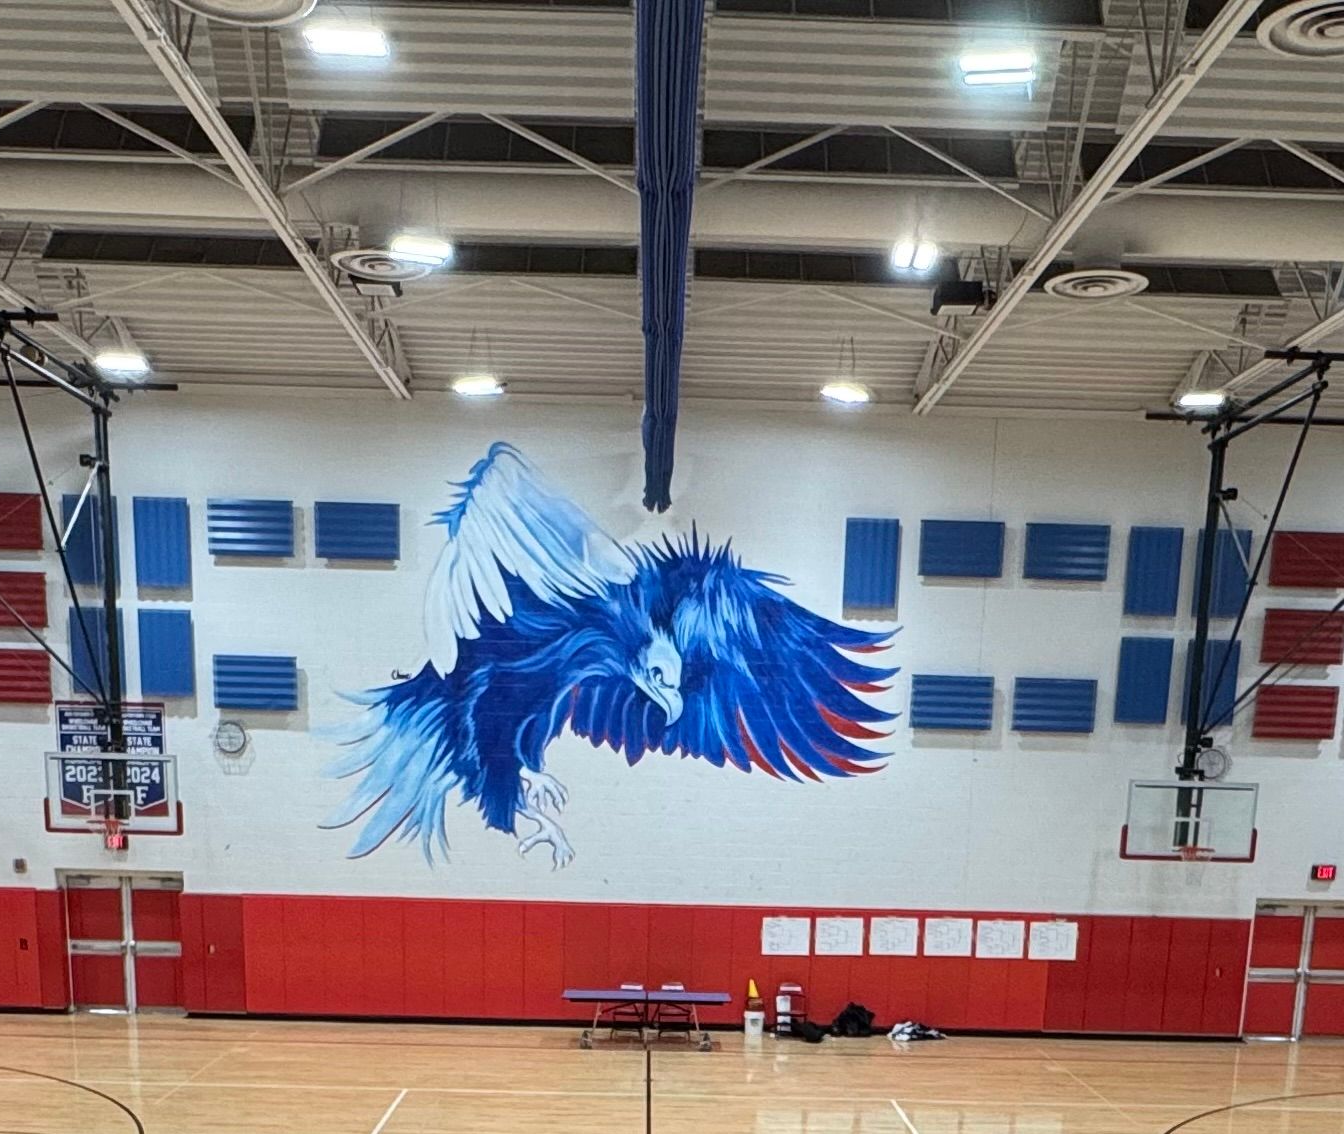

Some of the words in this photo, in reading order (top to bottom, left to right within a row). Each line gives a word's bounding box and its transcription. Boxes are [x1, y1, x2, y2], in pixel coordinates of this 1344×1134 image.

[72, 735, 98, 746] STATE
[127, 736, 153, 747] STATE
[136, 786, 149, 804] F
[1317, 866, 1334, 879] EXIT
